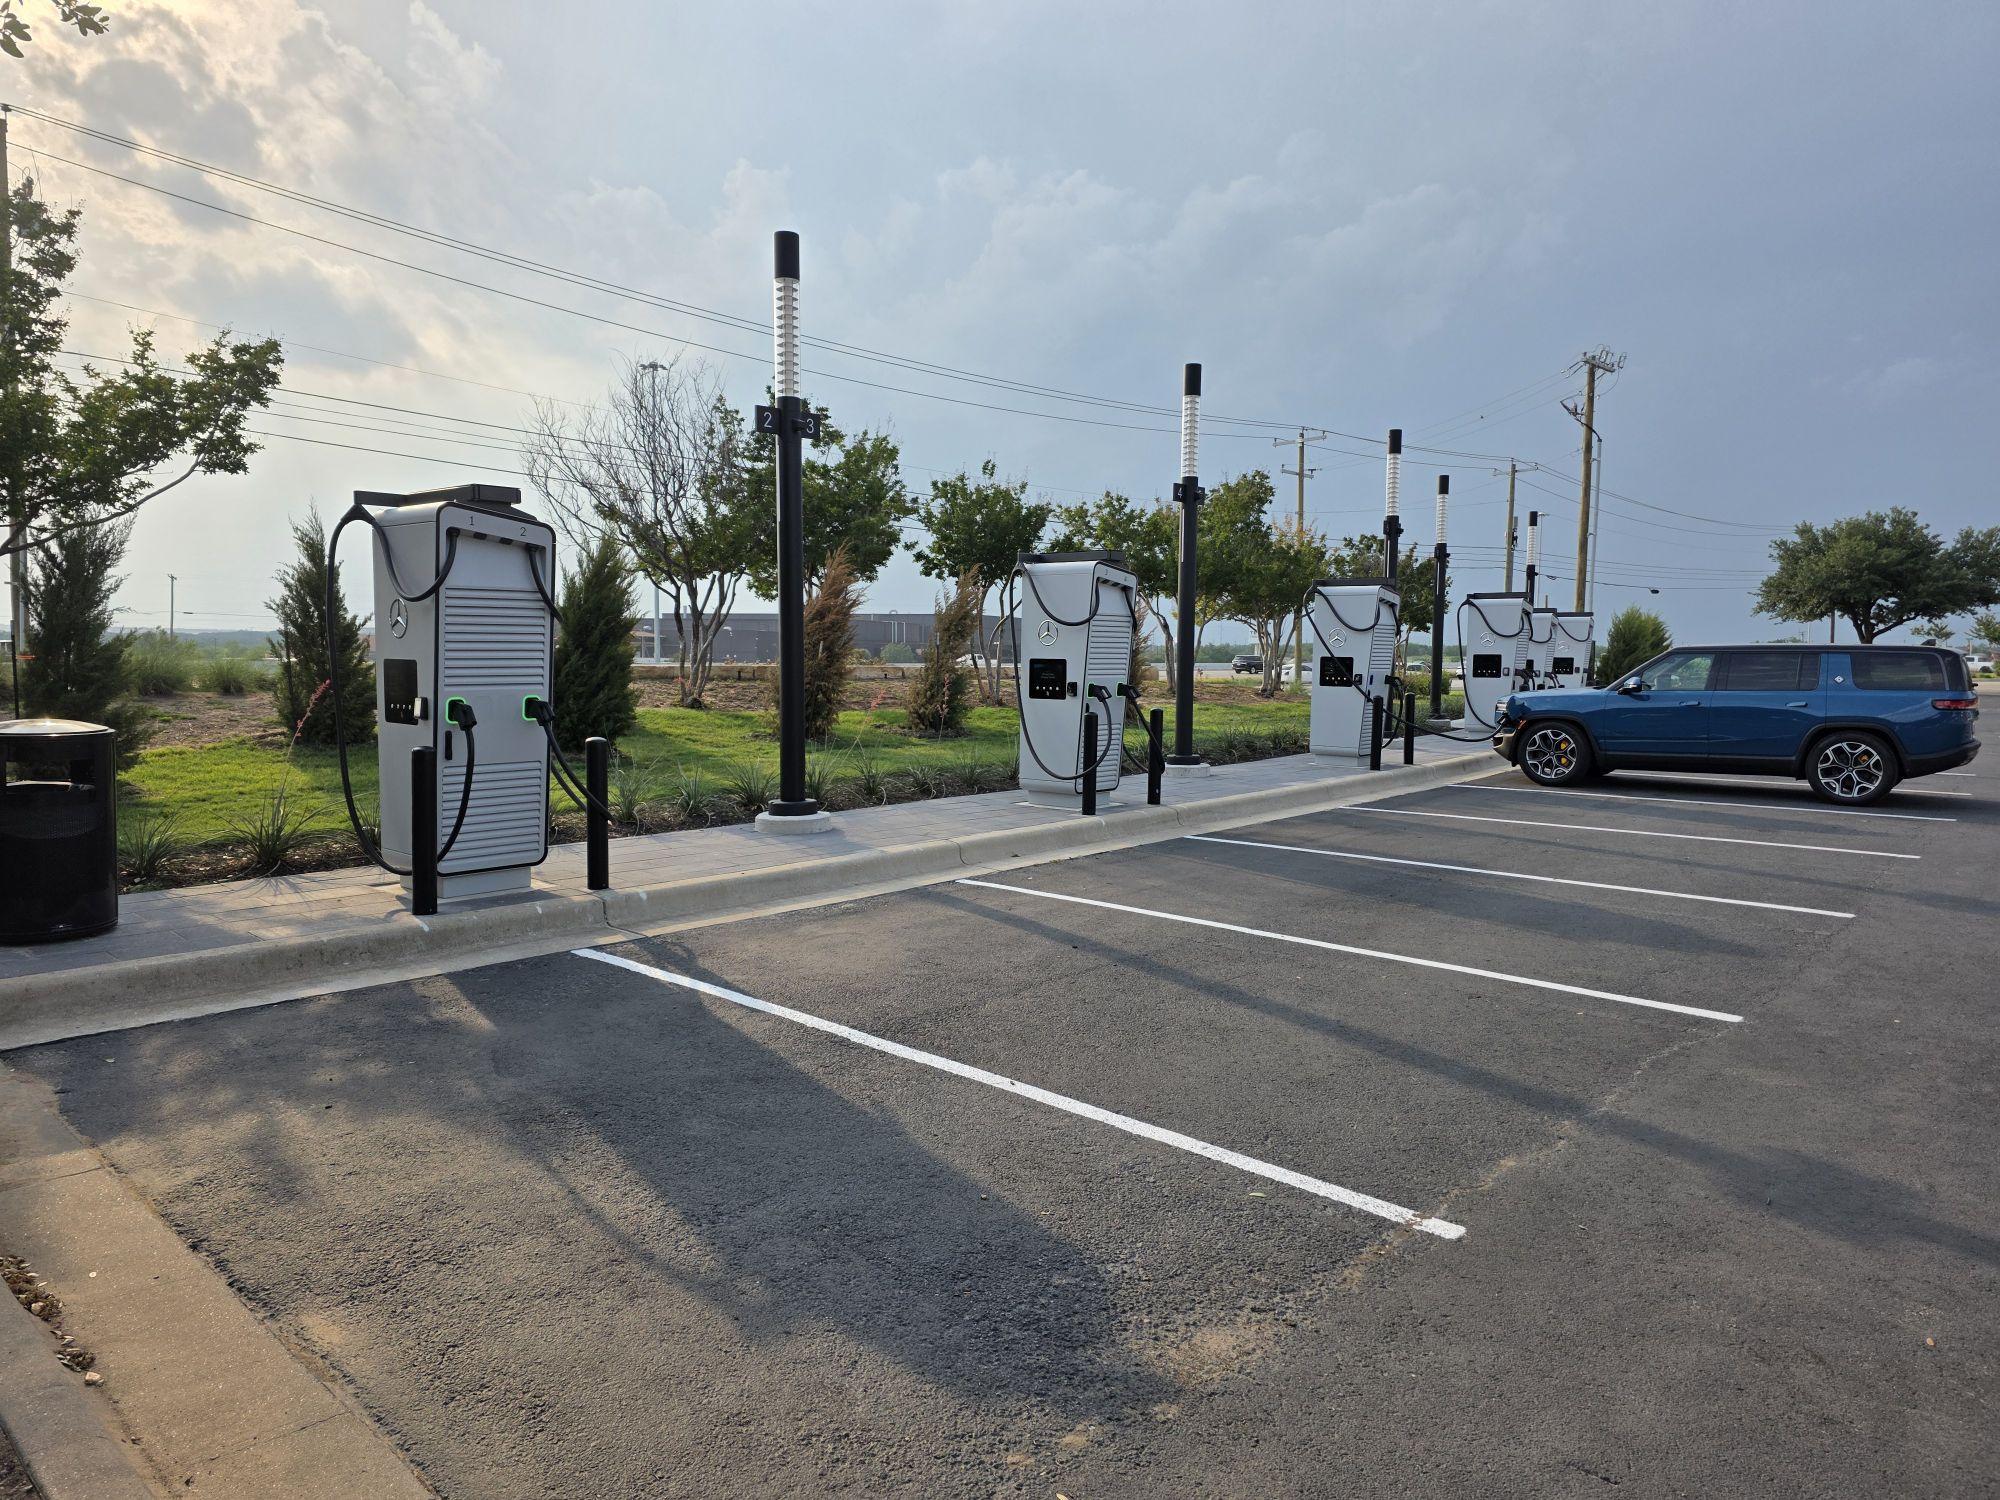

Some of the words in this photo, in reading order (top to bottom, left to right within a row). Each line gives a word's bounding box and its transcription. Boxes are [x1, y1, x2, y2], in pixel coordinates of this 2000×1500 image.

[763, 412, 773, 428] 2
[806, 418, 815, 434] 3
[469, 515, 475, 526] 1
[520, 526, 527, 537] 2
